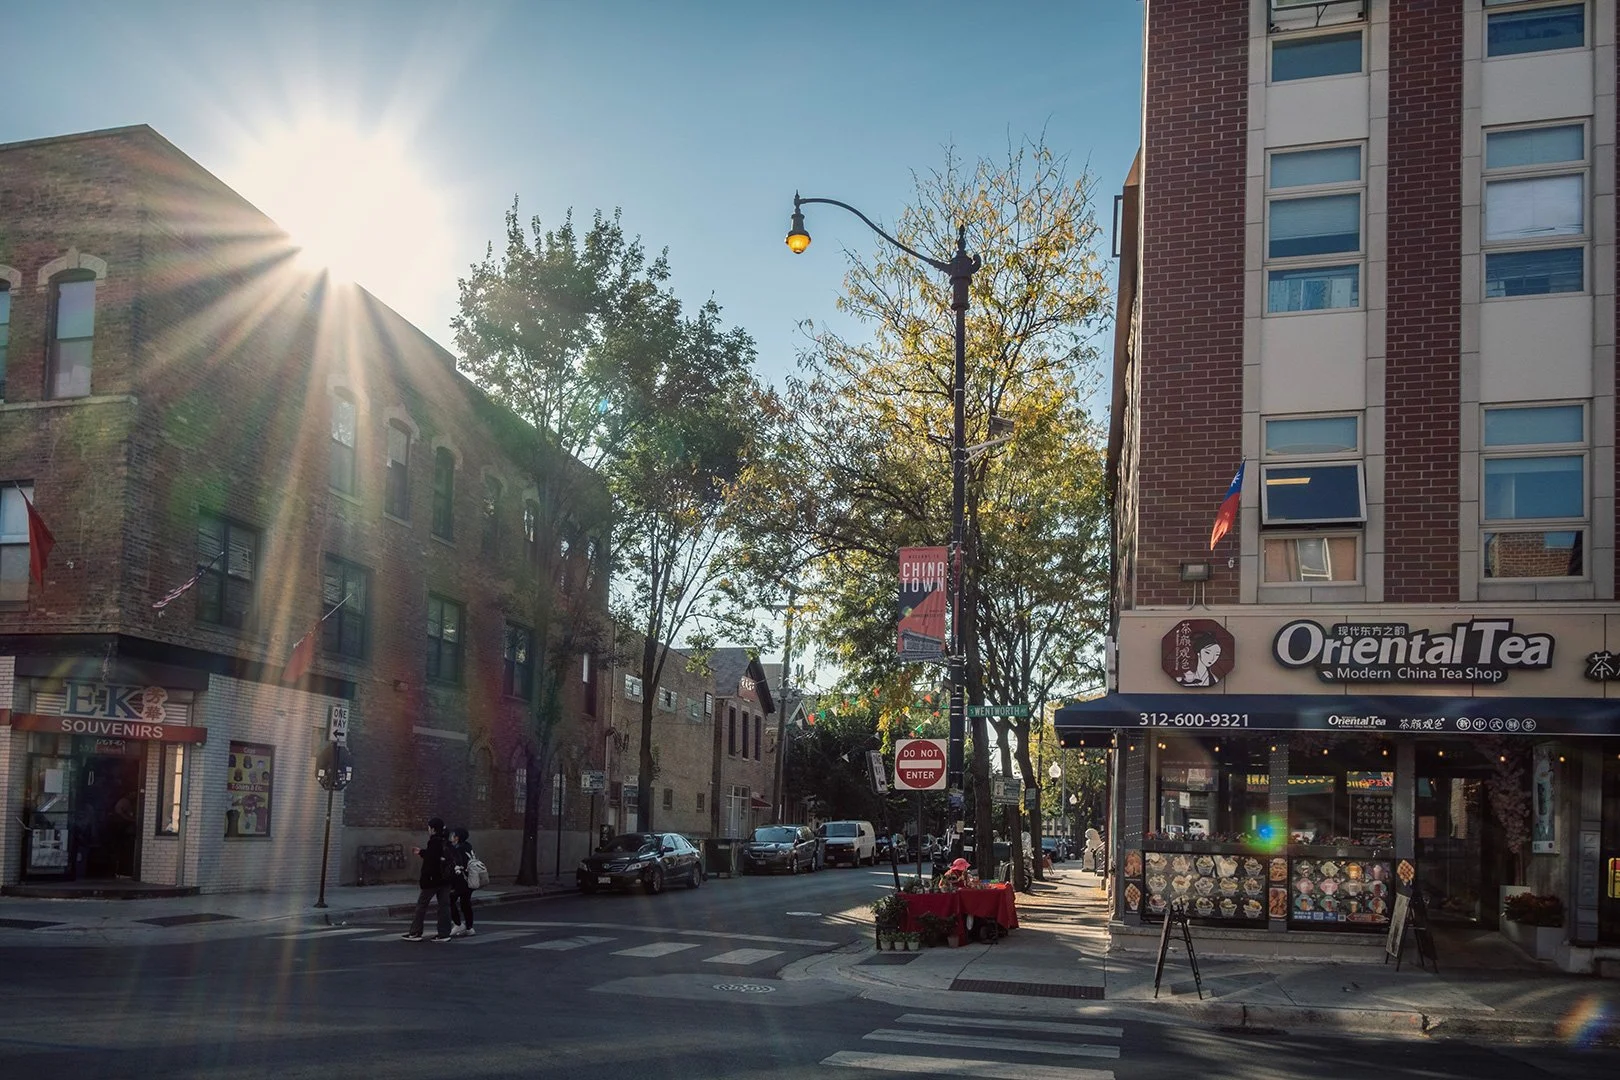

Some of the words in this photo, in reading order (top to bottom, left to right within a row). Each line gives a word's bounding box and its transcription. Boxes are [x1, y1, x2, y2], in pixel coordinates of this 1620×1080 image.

[902, 561, 945, 578] CHINA
[902, 577, 944, 593] TOWN
[1337, 626, 1405, 636] 现代东方之韵
[1277, 622, 1467, 665] Oriental
[1472, 621, 1550, 665] Tea
[1337, 667, 1391, 679] Modern
[1397, 667, 1437, 679] China
[1440, 667, 1463, 679] Tea
[1466, 667, 1502, 682] Shop
[64, 681, 144, 720] EK
[333, 708, 347, 719] ONE
[974, 706, 1020, 716] WENTWORTH
[333, 719, 346, 728] WAY
[1139, 712, 1249, 727] 312-600-9321
[1328, 714, 1369, 726] Oriental
[1369, 715, 1387, 726] Tea
[61, 719, 164, 738] SOUVENIRS
[903, 749, 916, 758] DO
[920, 749, 939, 757] NOT
[906, 771, 935, 779] ENTER
